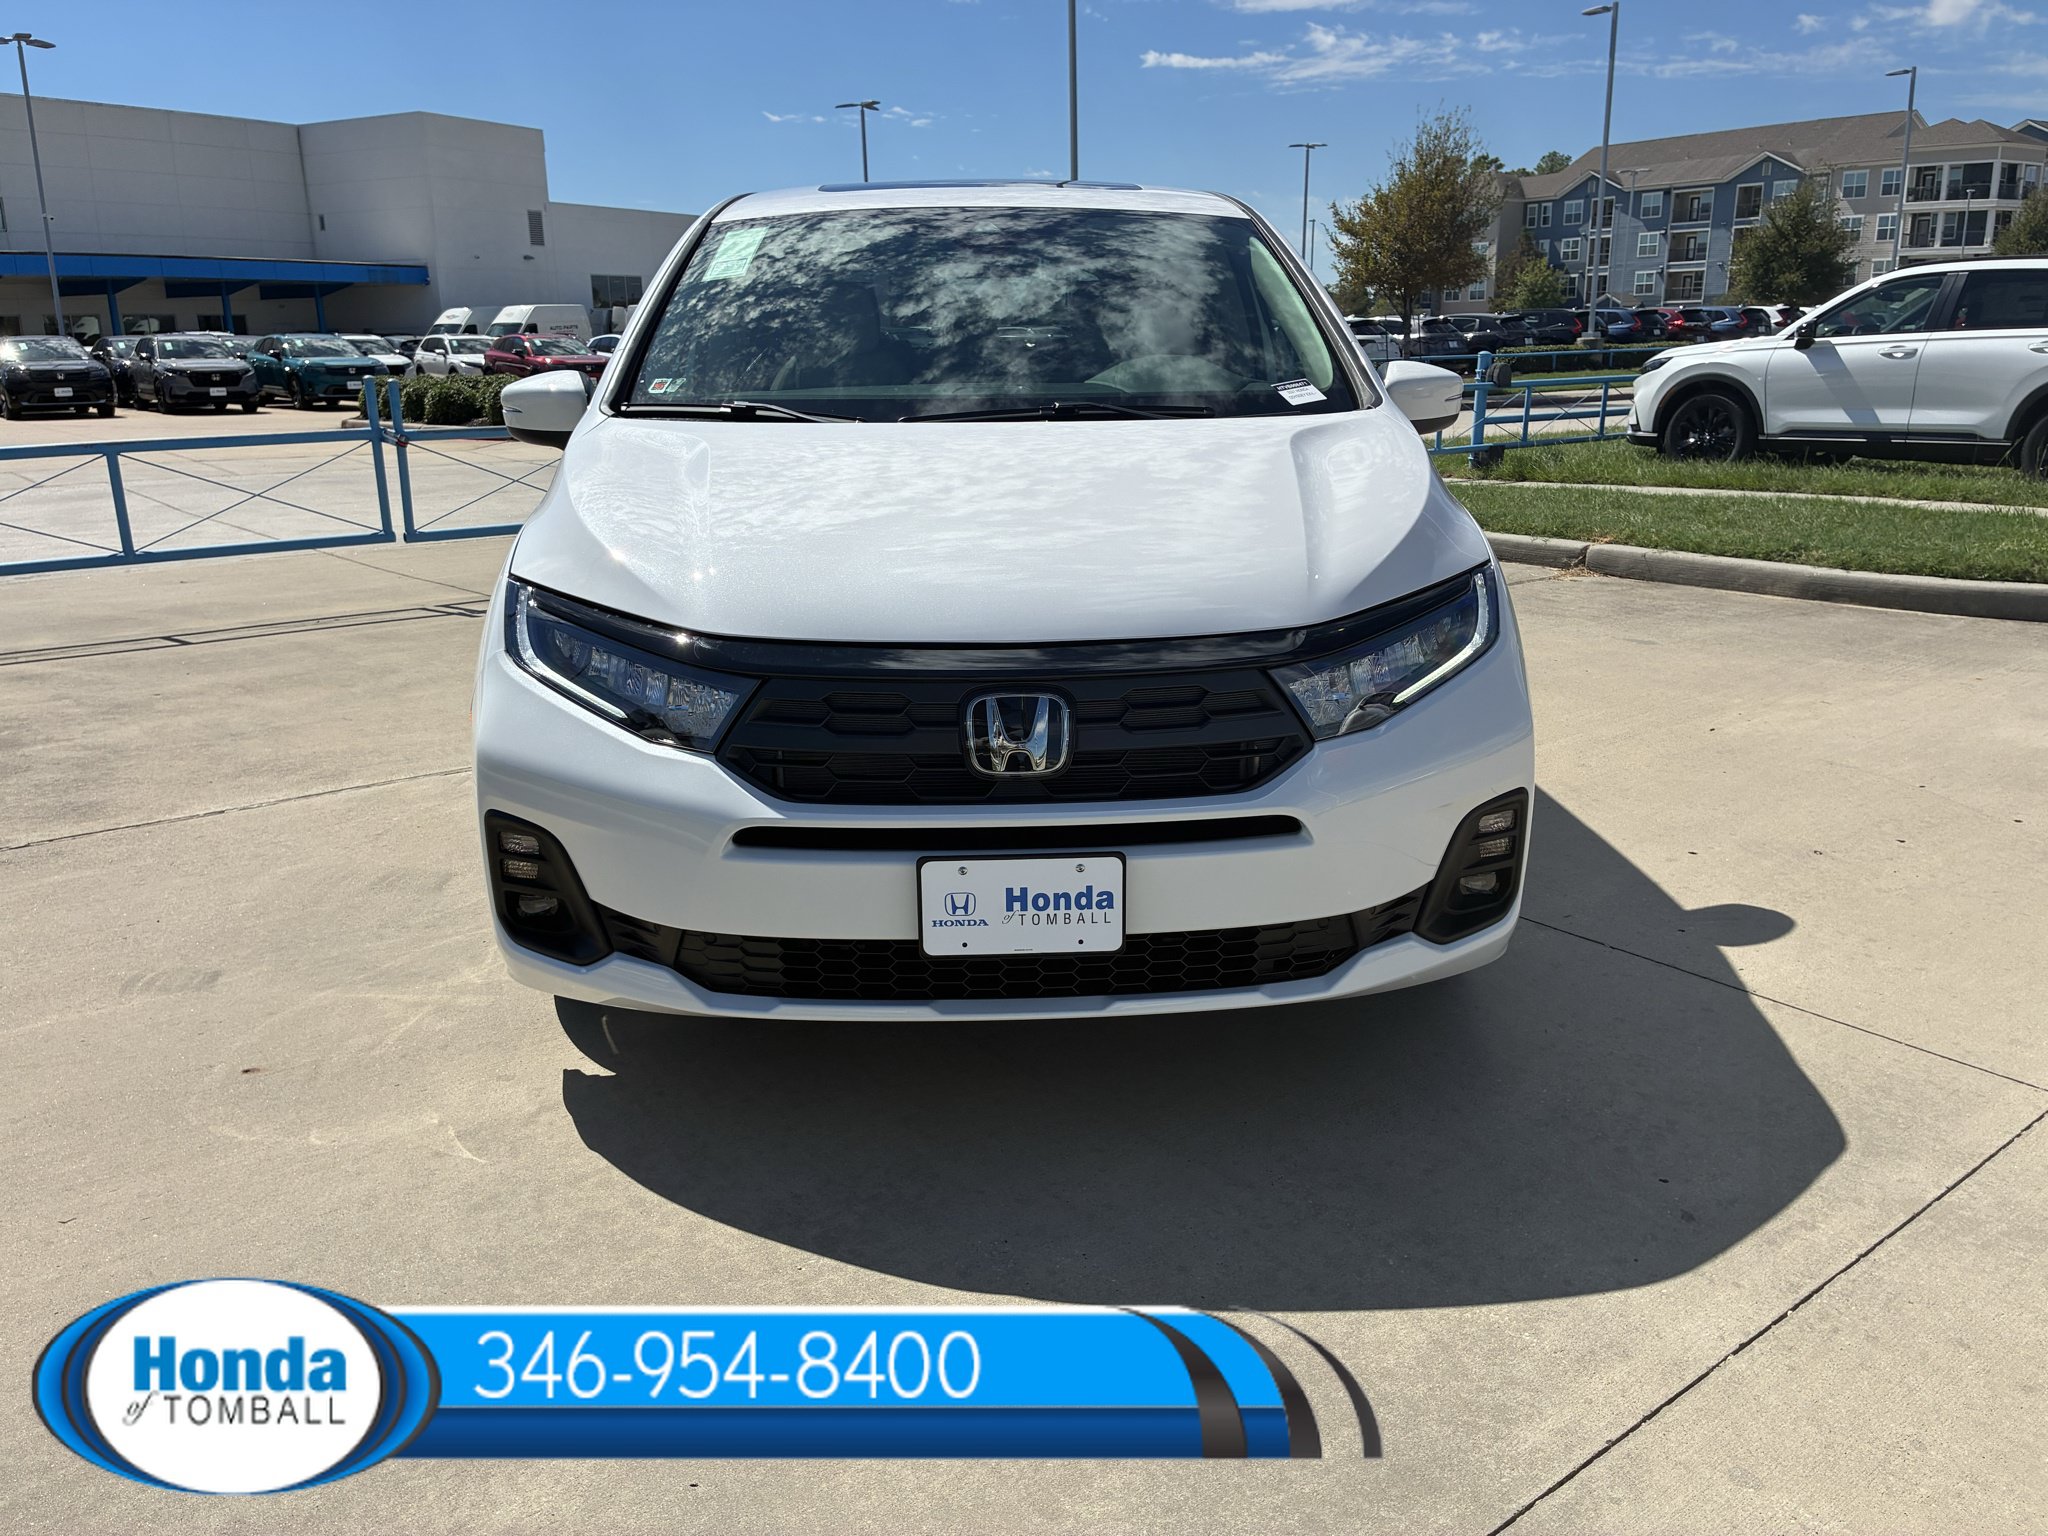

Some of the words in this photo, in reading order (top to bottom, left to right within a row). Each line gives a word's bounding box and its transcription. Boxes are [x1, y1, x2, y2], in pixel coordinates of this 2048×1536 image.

[1005, 885, 1115, 912] Honda
[931, 919, 989, 928] HONDA
[1001, 910, 1019, 925] of
[1019, 912, 1111, 926] TOMBALL
